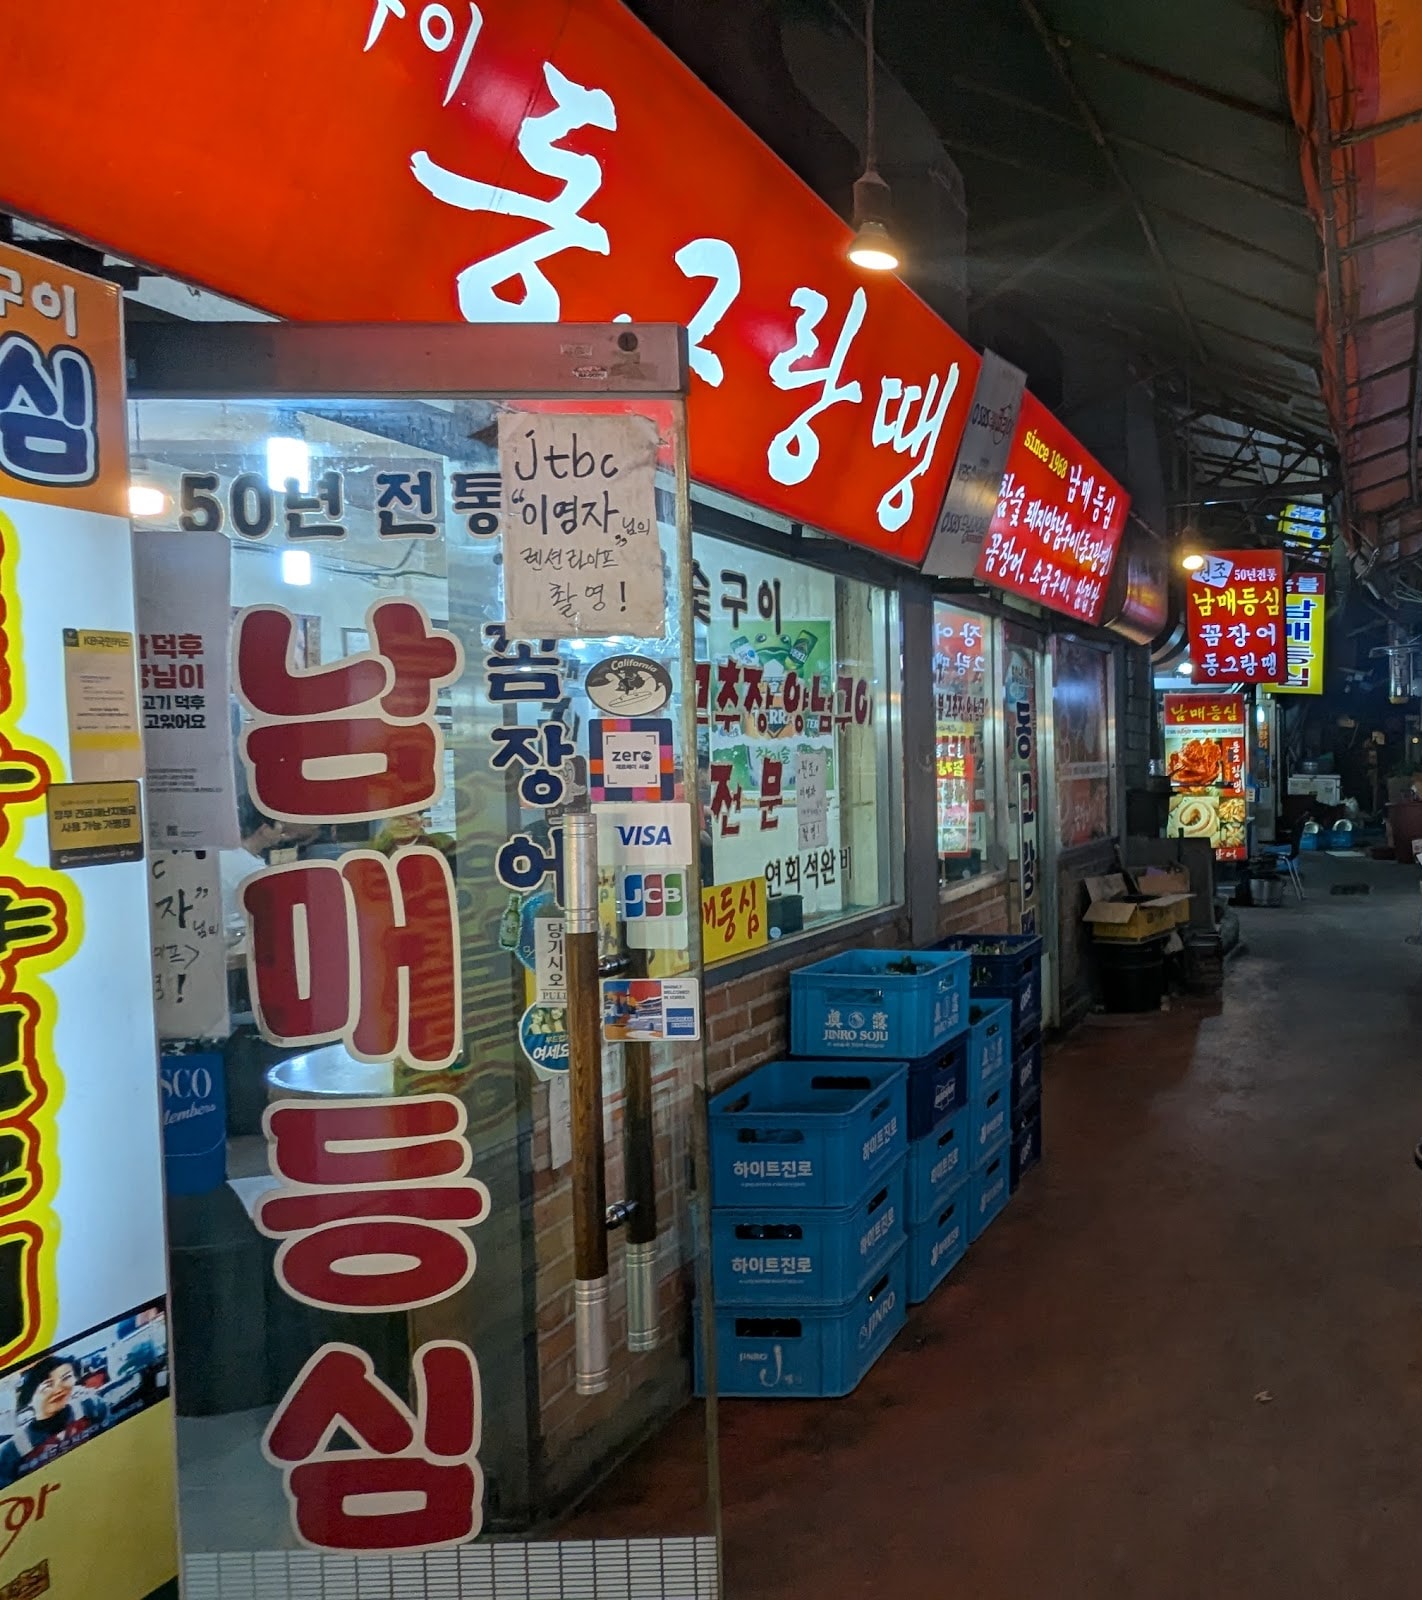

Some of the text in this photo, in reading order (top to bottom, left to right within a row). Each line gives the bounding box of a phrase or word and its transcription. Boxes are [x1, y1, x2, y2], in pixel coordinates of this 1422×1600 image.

[364, 0, 483, 106] 이
[411, 62, 960, 533] 동그랑땡
[1023, 429, 1069, 480] since 1968
[179, 469, 501, 540] 50년 전통
[1067, 464, 1116, 530] 남매등심
[1028, 558, 1071, 604] 소금구이,
[1234, 567, 1278, 583] 50년전통
[1192, 586, 1280, 617] 남매등심
[1198, 622, 1278, 648] 꼼장어
[610, 658, 658, 673] California
[1200, 652, 1278, 677] 동그랑땡
[174, 694, 205, 711] 덕후
[1170, 702, 1237, 723] 남매등심
[710, 756, 783, 837] 전문
[614, 825, 672, 846] VISA
[765, 846, 852, 899] 연회석완비
[547, 923, 565, 987] 당기시오
[822, 1030, 889, 1042] JINRO SOJU
[239, 597, 490, 1551] 남매등심
[164, 1101, 217, 1126] embers
[862, 1115, 898, 1162] 하이트진로
[733, 1160, 813, 1179] 하이트진로
[930, 1146, 959, 1184] 하이트진로
[859, 1206, 896, 1257] 하이트진로
[731, 1256, 813, 1275] 하이트진로
[866, 1290, 897, 1341] JINRO
